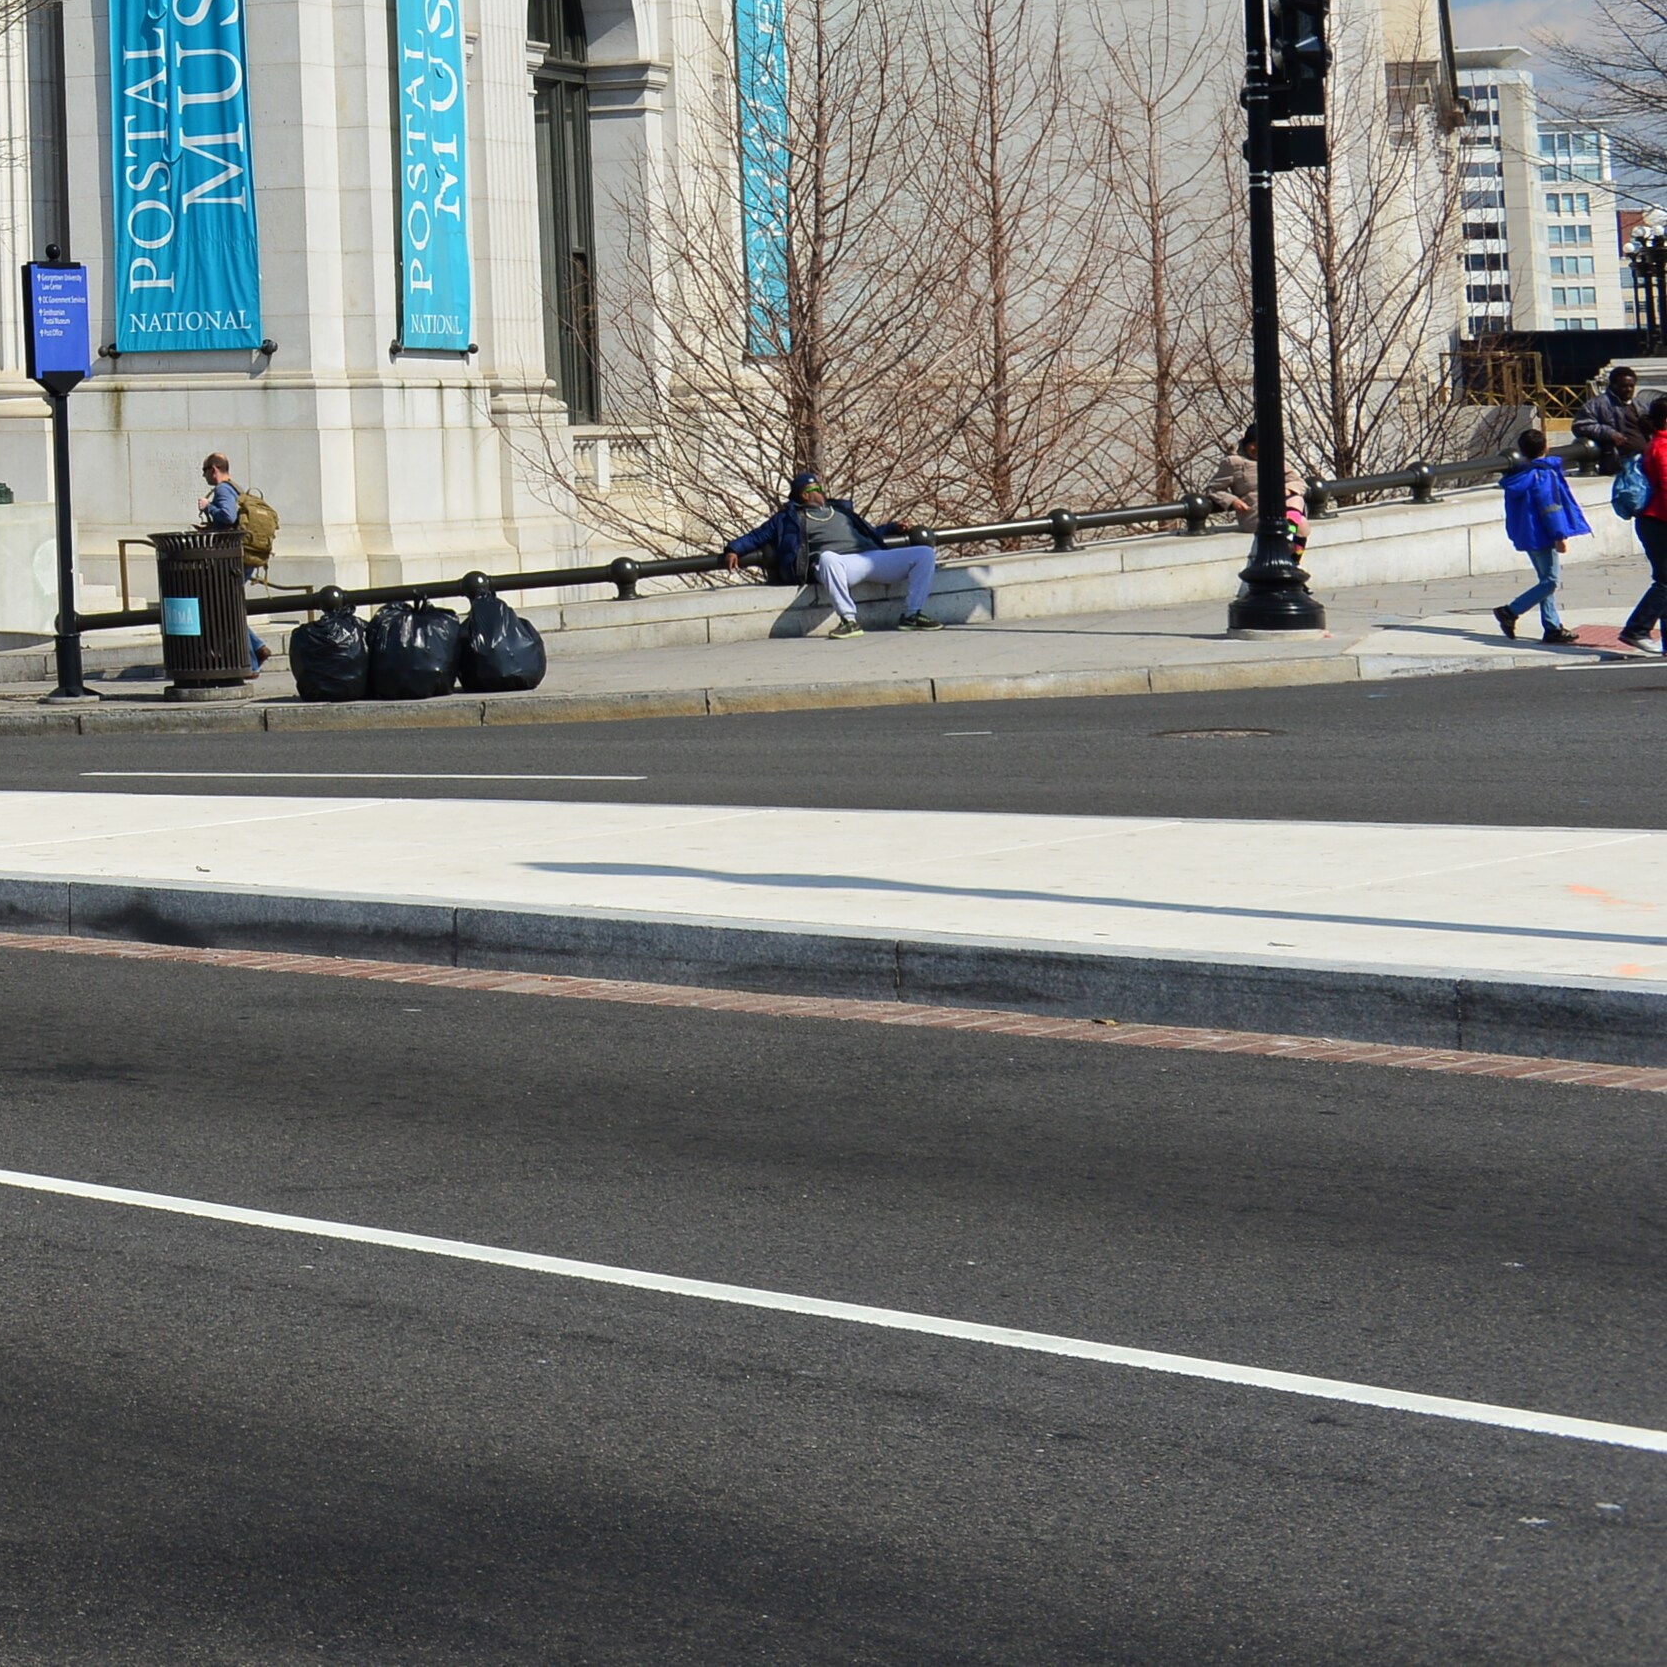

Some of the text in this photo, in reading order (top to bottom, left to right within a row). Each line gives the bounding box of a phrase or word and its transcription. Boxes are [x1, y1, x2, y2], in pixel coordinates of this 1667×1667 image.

[122, 26, 175, 294] POSTAL
[403, 29, 433, 295] POSTAL
[129, 310, 252, 333] NATIONAL
[410, 314, 463, 335] NATIONAL
